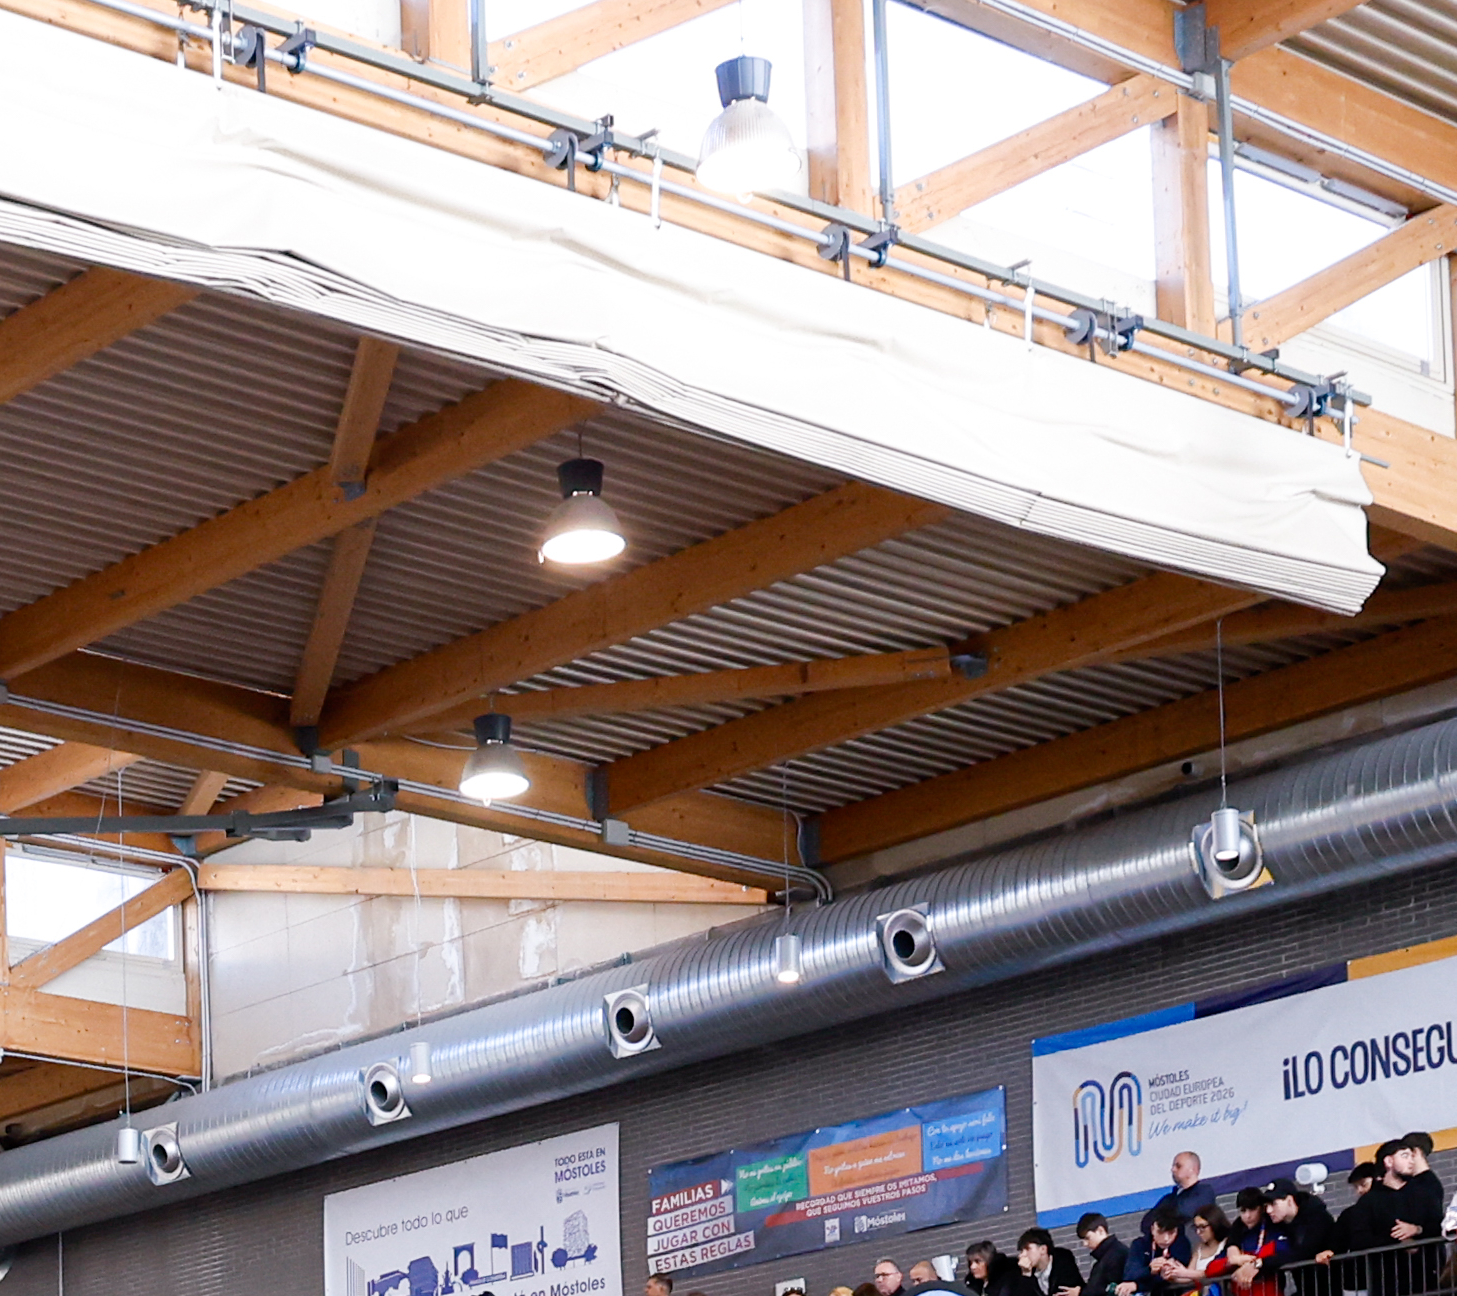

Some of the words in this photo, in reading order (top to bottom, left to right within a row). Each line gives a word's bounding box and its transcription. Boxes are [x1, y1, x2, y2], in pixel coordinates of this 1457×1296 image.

[1148, 1069, 1190, 1089] MÓSTOLES
[1282, 1048, 1323, 1101] ¡LO
[1149, 1085, 1181, 1103] CIUDAD
[1183, 1076, 1225, 1096] EUROPEA
[1150, 1103, 1167, 1116] DEL
[1168, 1093, 1209, 1112] DEPORTE
[1209, 1087, 1235, 1103] 2026
[1148, 1121, 1172, 1140] We
[1172, 1114, 1207, 1131] make
[554, 1154, 576, 1168] TODO
[595, 1147, 607, 1159] EN
[554, 1160, 607, 1184] MÓSTOLES
[651, 1184, 714, 1214] FAMILIAS
[837, 1193, 853, 1203] QUE
[854, 1186, 885, 1200] SIEMPRE
[887, 1183, 897, 1194] OS
[901, 1184, 927, 1197] PASOS
[345, 1221, 398, 1247] Descubre
[401, 1214, 429, 1234] todo
[431, 1211, 443, 1227] lo
[445, 1204, 470, 1227] que
[652, 1201, 726, 1233] QUEREMOS
[653, 1227, 699, 1253] JUGAR
[702, 1219, 731, 1239] CON
[654, 1251, 698, 1272] ESTAS
[700, 1236, 752, 1261] REGLAS
